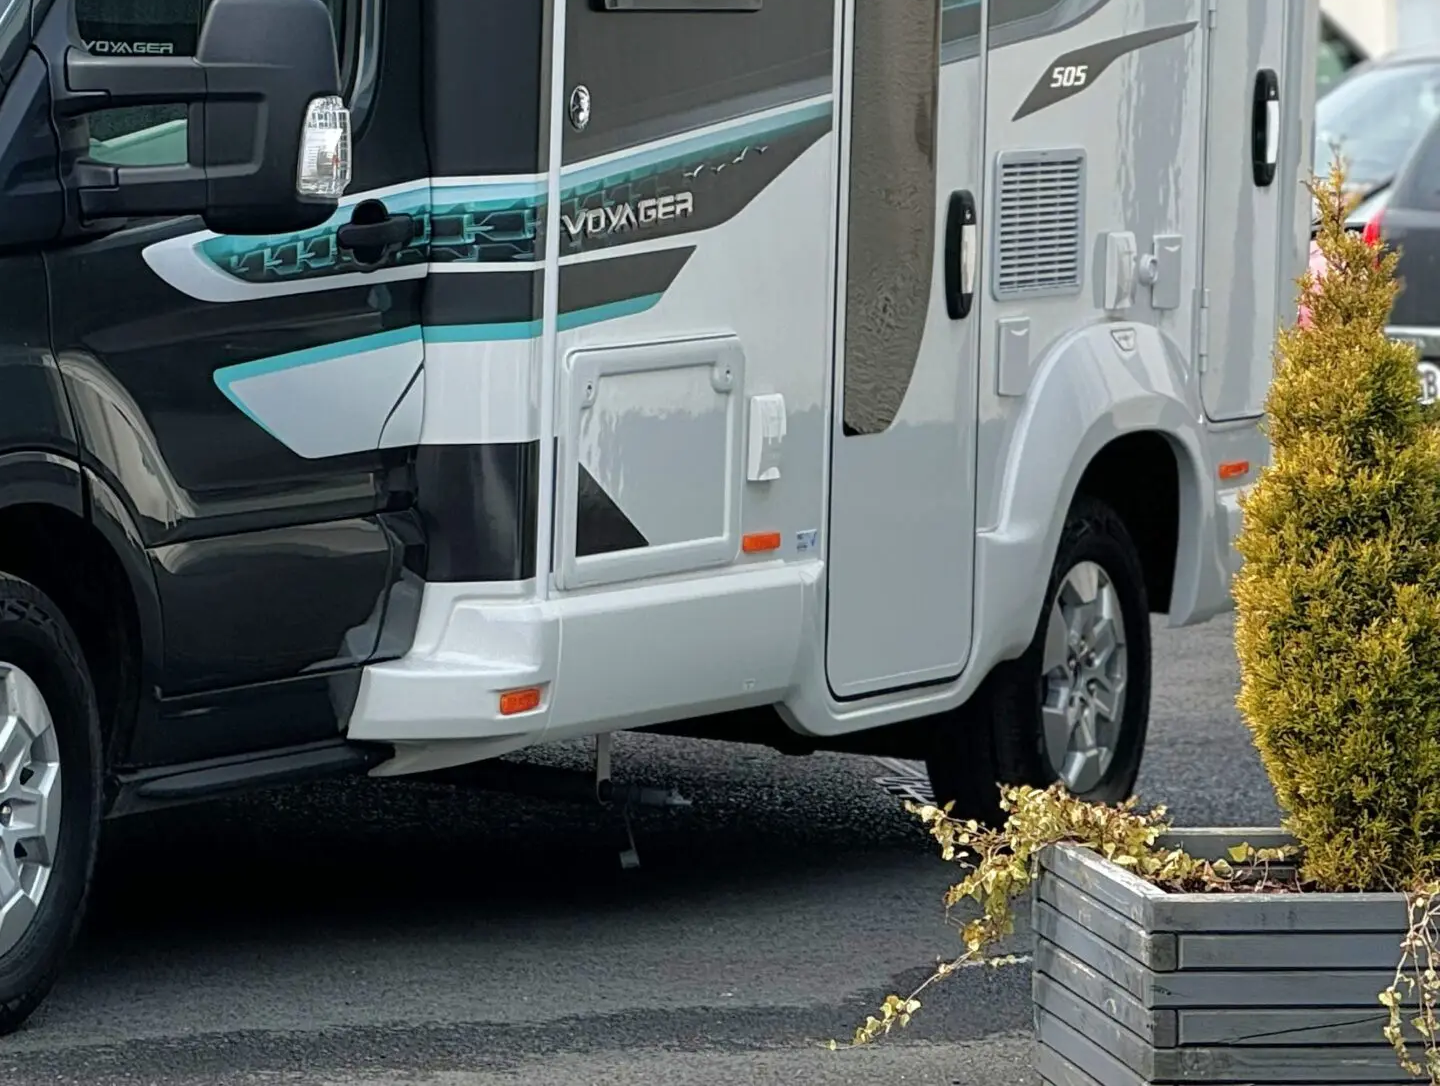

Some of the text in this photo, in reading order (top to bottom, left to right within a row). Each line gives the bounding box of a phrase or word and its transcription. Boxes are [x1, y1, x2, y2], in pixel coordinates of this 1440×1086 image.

[81, 39, 173, 53] VOYAGER
[1050, 65, 1088, 87] 505
[562, 191, 693, 237] VOYAGER
